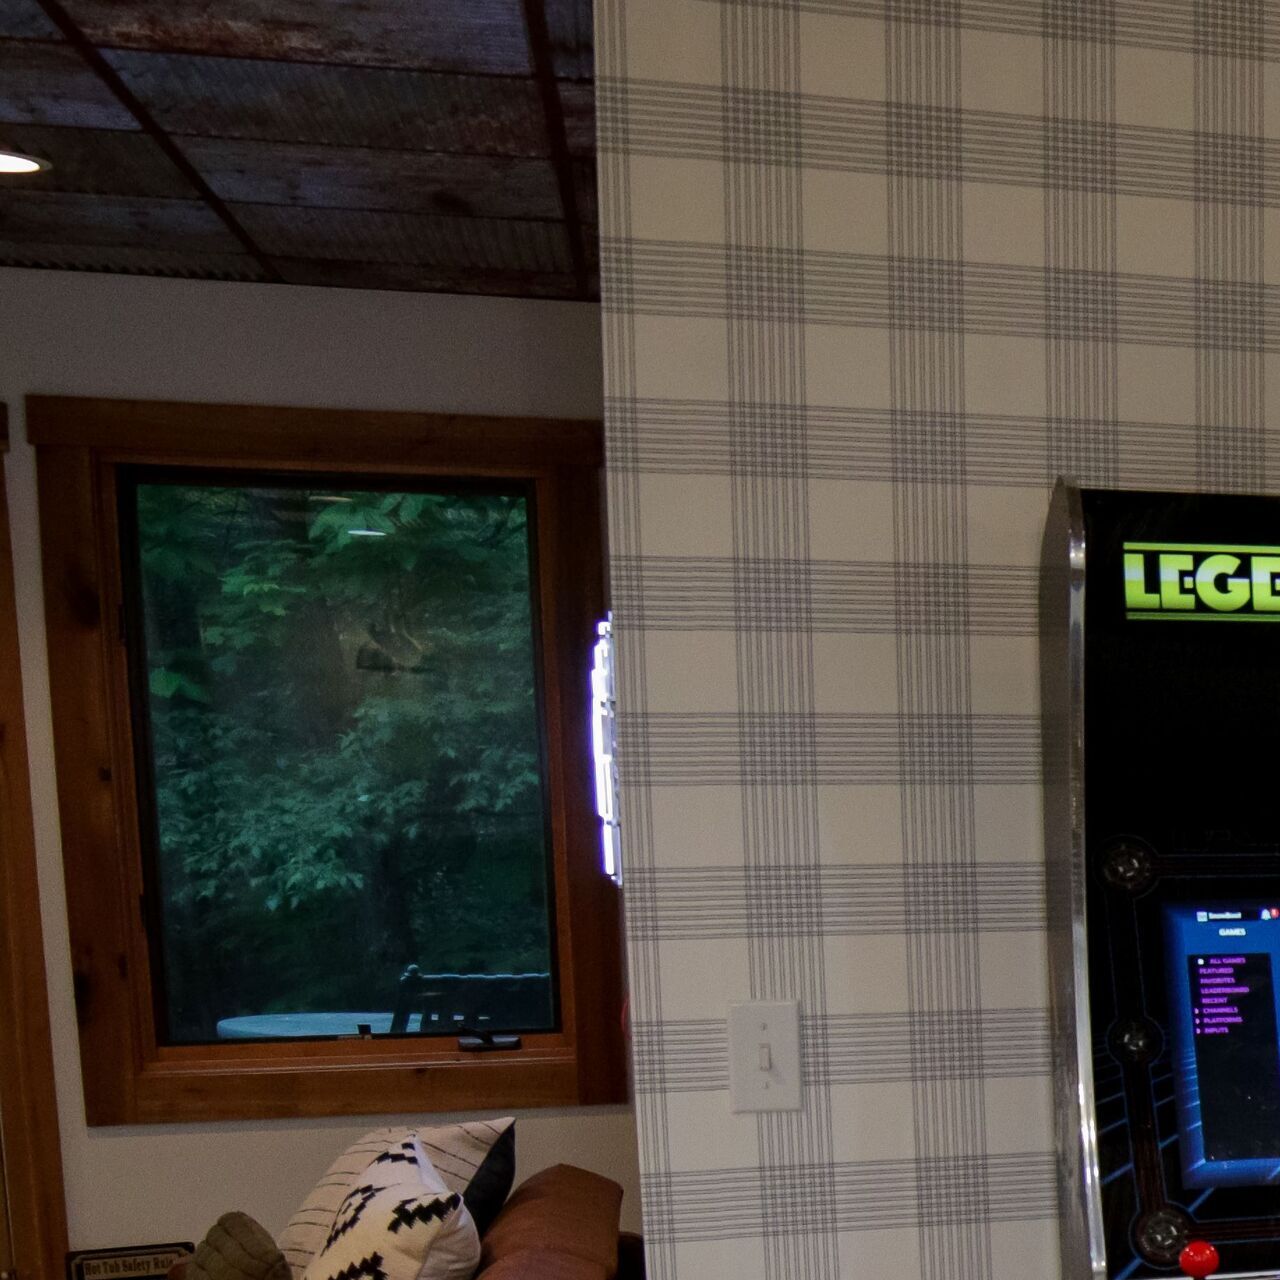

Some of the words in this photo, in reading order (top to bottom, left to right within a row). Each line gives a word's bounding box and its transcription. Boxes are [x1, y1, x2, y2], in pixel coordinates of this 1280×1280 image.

[1218, 928, 1247, 937] GAMES
[122, 1257, 150, 1274] Safety
[152, 1256, 174, 1271] Rule
